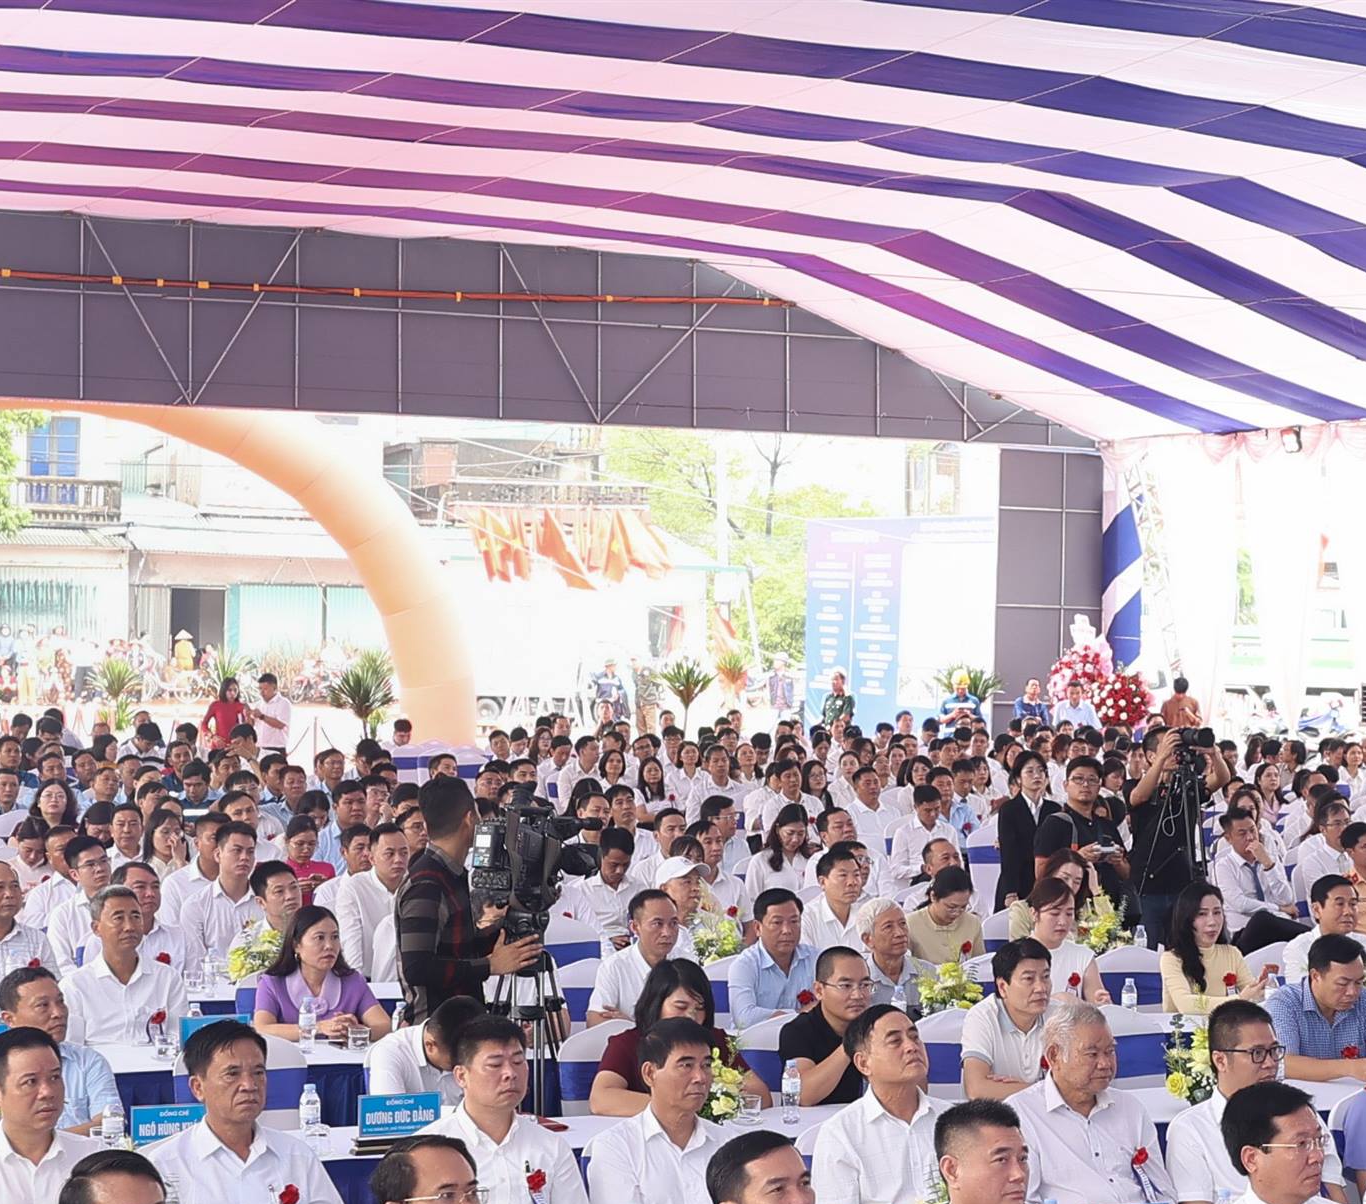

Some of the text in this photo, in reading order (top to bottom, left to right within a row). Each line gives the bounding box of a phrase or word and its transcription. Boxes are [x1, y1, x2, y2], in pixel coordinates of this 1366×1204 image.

[365, 1110, 393, 1125] DƯƠNG
[394, 1107, 411, 1123] ĐỨC
[139, 1120, 156, 1136] NGÔ
[157, 1120, 180, 1136] HÙNG
